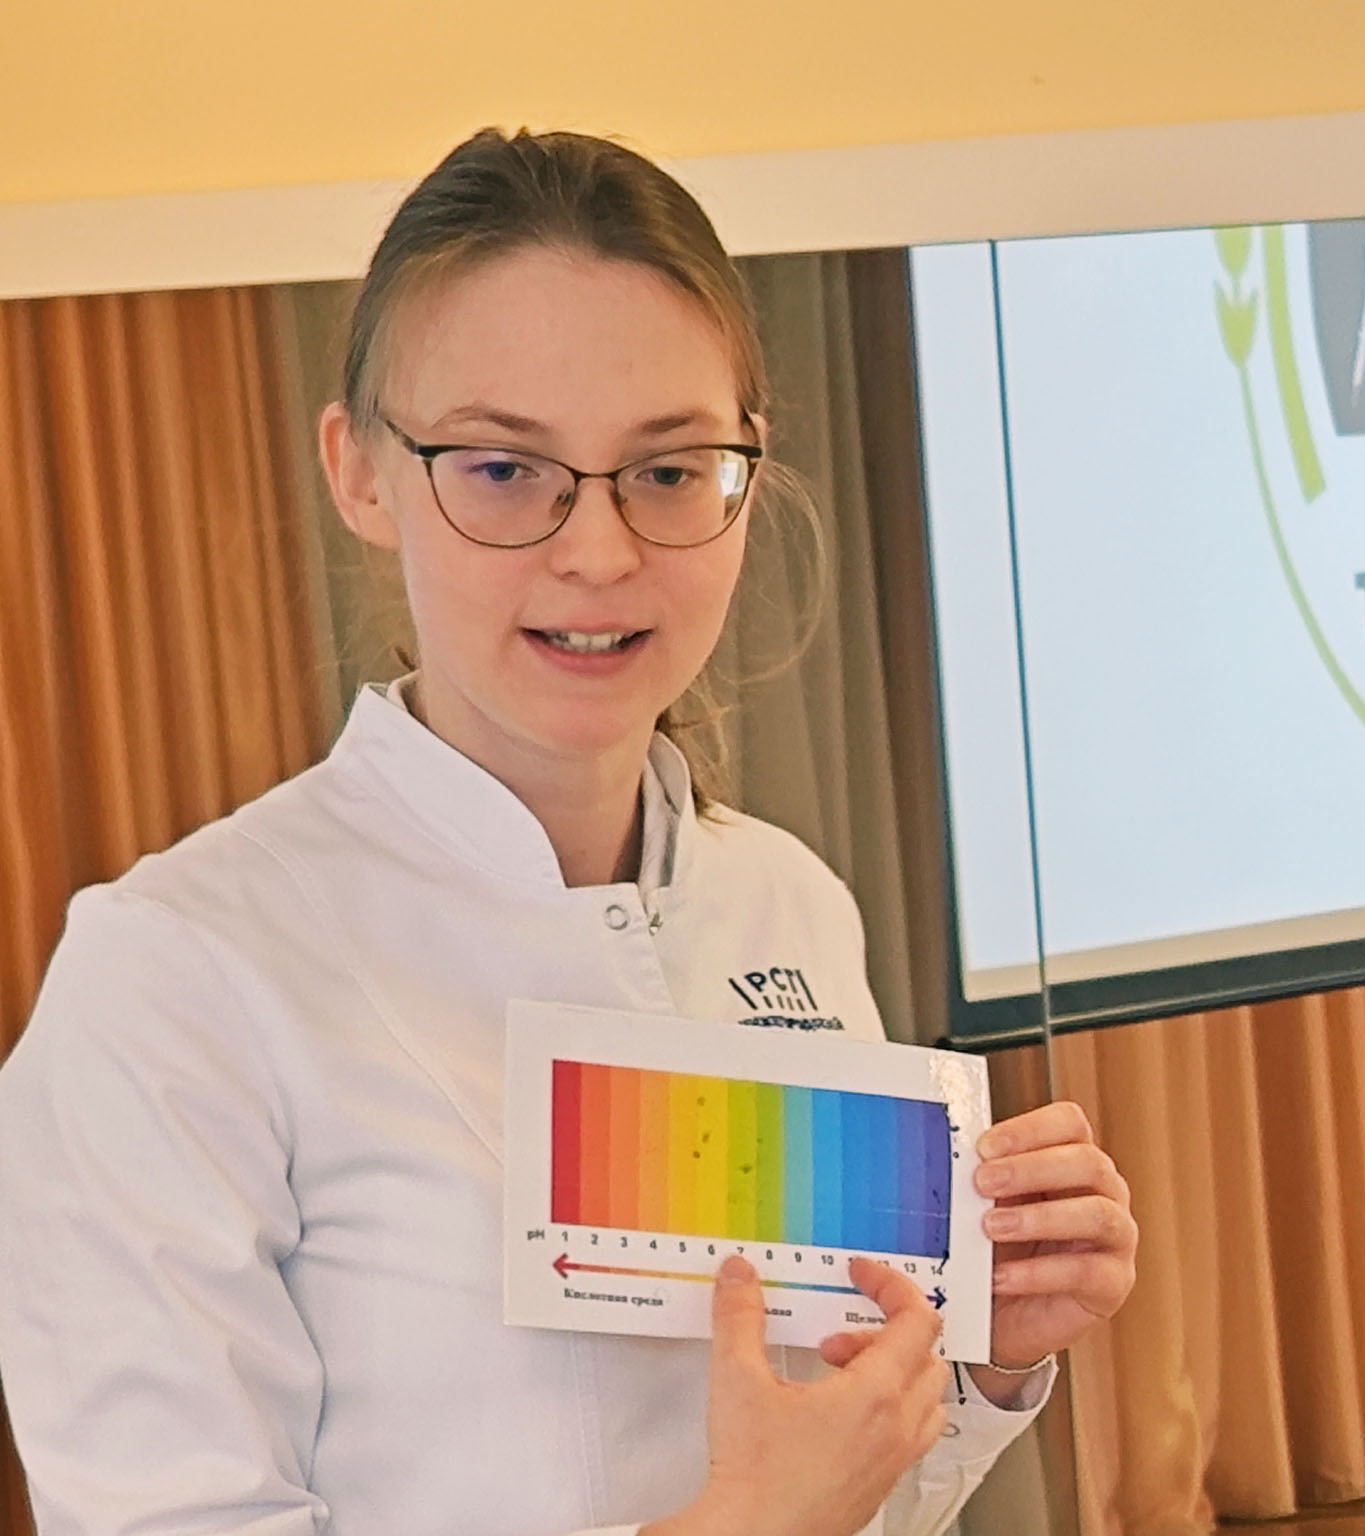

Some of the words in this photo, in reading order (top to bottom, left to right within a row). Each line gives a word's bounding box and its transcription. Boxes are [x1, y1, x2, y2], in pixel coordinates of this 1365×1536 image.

[562, 1232, 569, 1242] 1
[590, 1233, 599, 1246] 2
[620, 1236, 629, 1248] 3
[649, 1239, 657, 1250] 4
[679, 1241, 687, 1253] 5
[707, 1244, 716, 1256] 6
[765, 1249, 774, 1261] 8
[794, 1252, 803, 1263] 9
[821, 1254, 835, 1266] 10
[903, 1262, 917, 1274] 13
